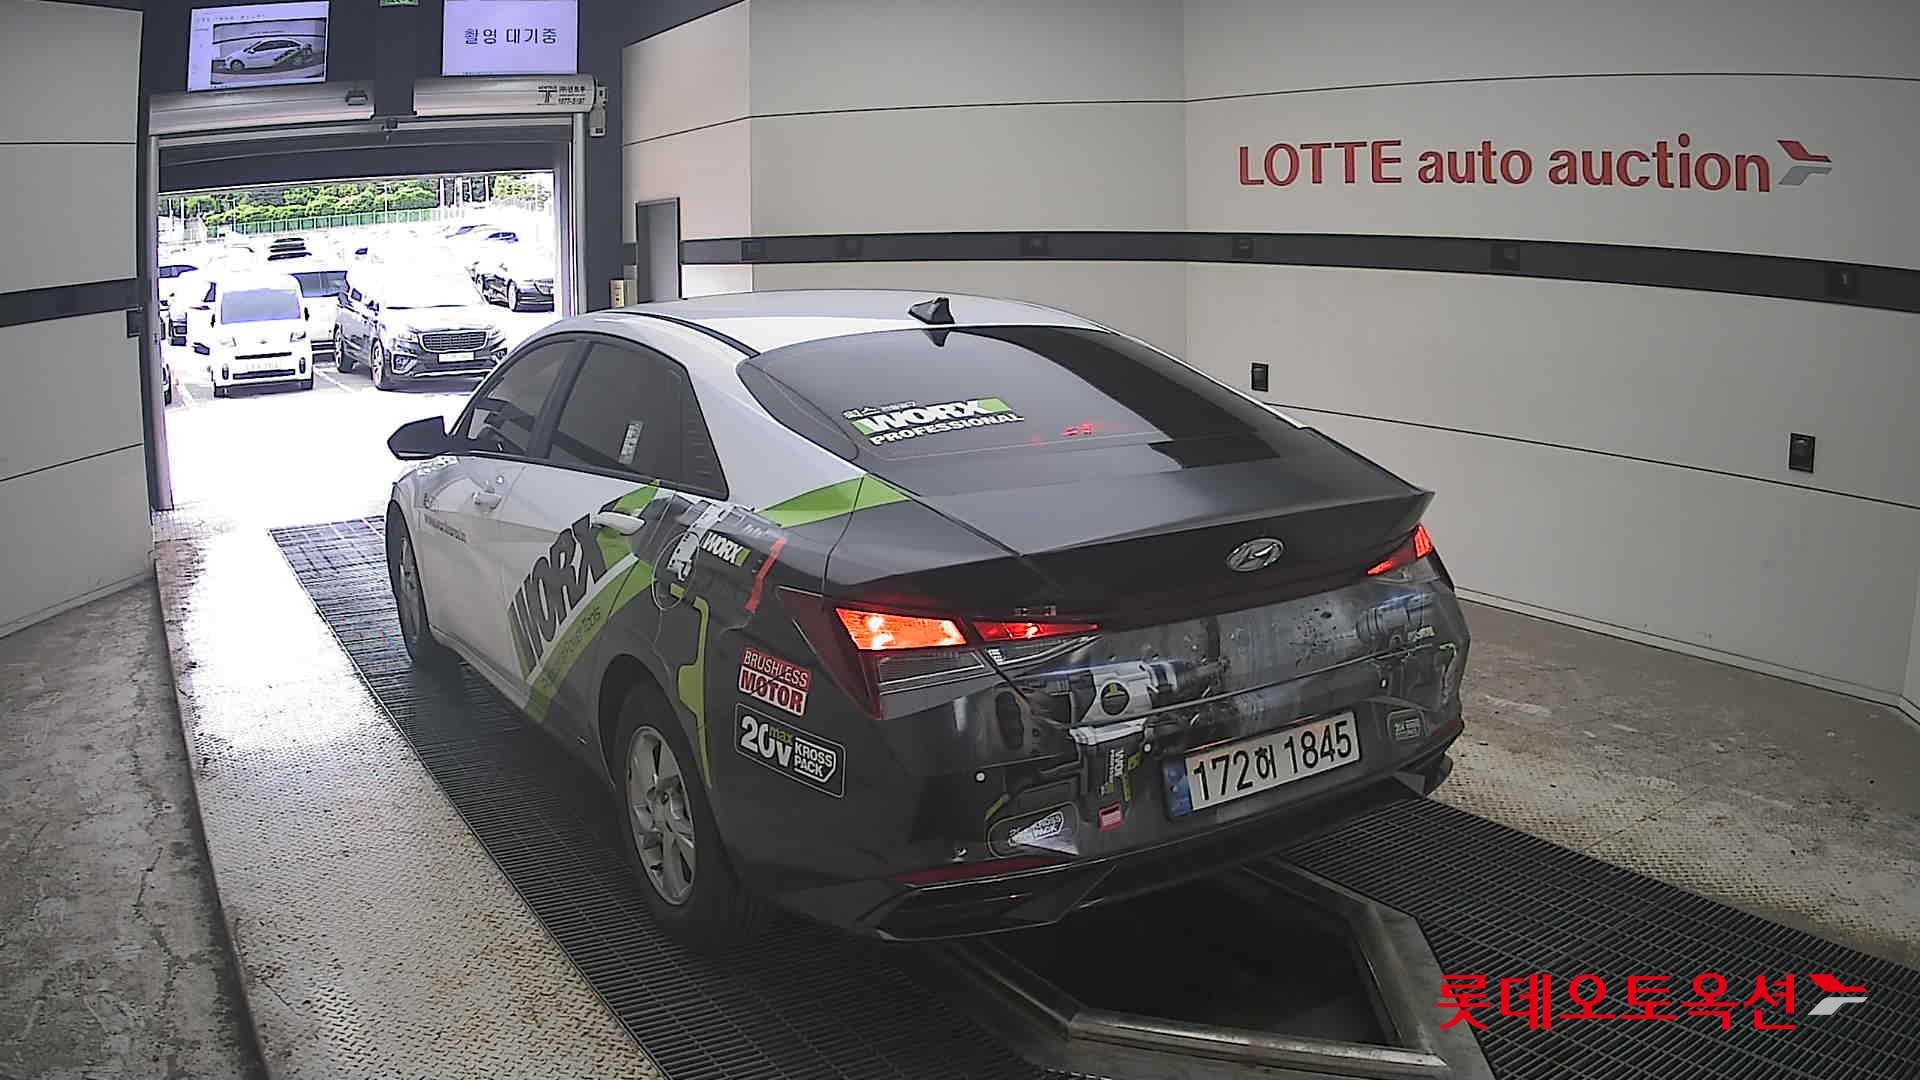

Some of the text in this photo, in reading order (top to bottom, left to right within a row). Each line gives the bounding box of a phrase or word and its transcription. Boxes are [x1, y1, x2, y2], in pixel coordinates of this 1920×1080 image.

[506, 28, 558, 45] 대기중
[1239, 133, 1770, 193] LOTTE auto auction
[865, 399, 986, 433] WORX
[870, 413, 1024, 446] PROFESSIONAL
[701, 531, 744, 564] WORX
[743, 650, 808, 688] BRUSHLESS
[740, 669, 804, 714] MOTOR
[794, 743, 833, 767] KROSS
[794, 757, 824, 778] PACK
[1193, 720, 1353, 801] 172허 1845
